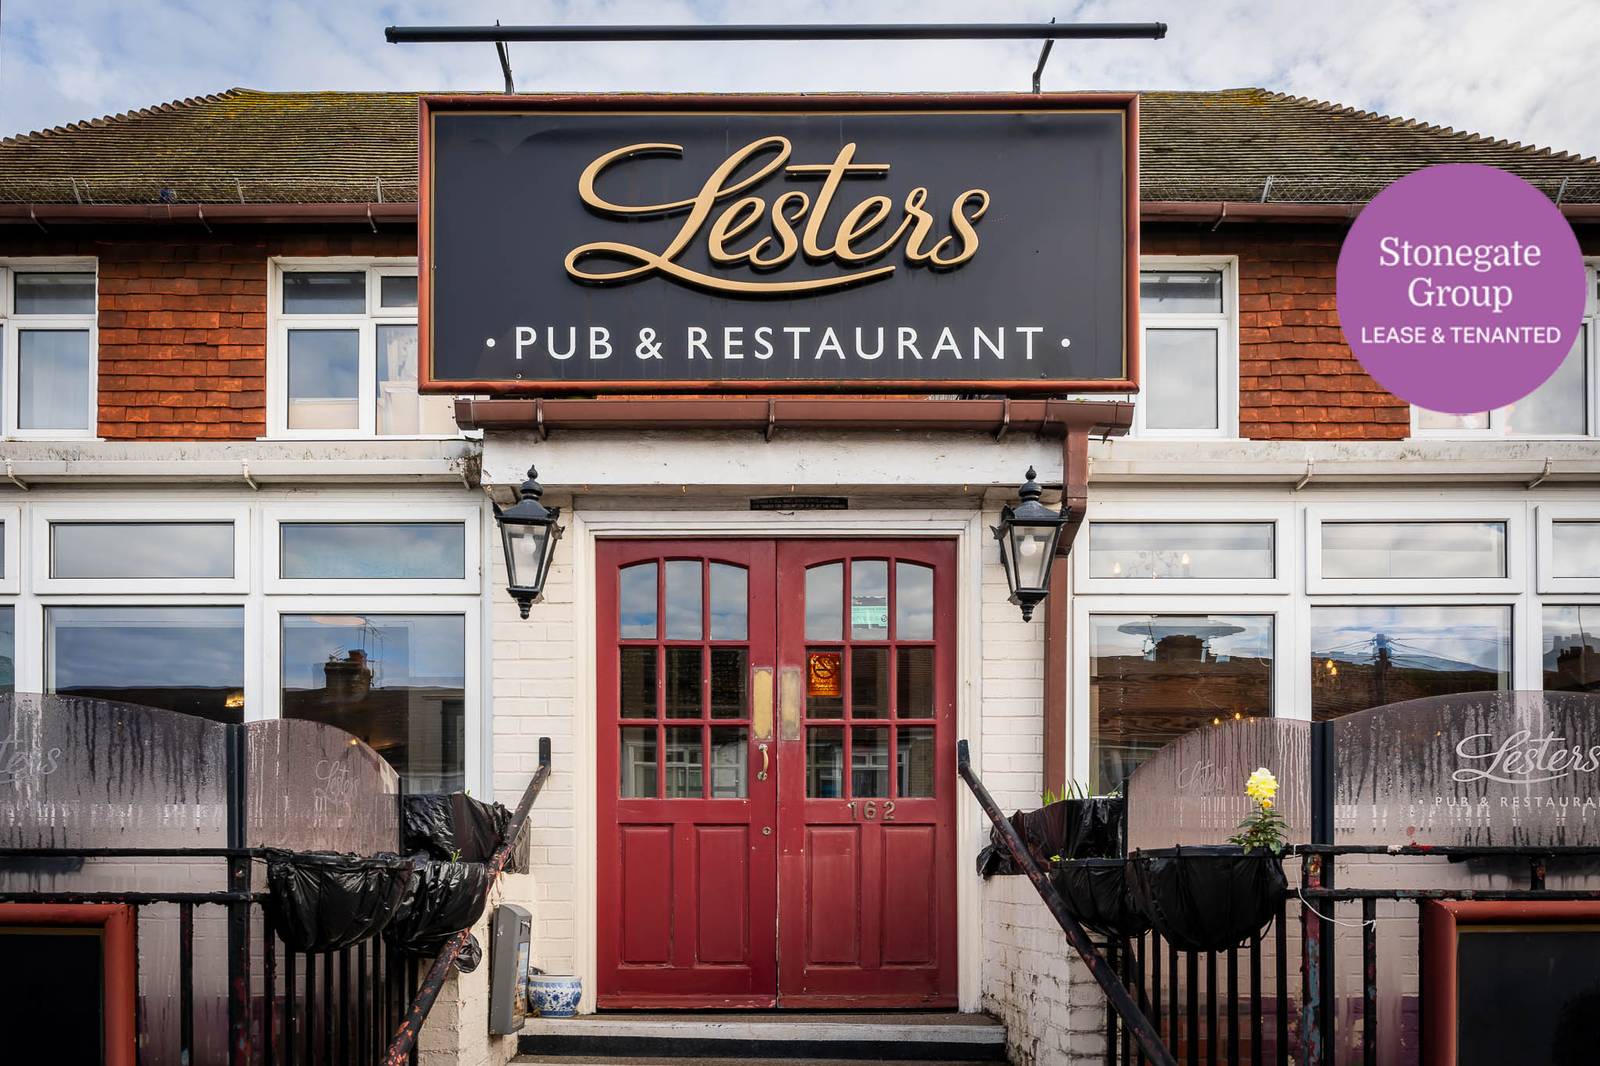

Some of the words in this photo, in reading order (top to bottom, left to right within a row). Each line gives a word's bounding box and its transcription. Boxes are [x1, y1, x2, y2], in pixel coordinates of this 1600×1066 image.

[565, 136, 990, 293] Lesters
[515, 327, 613, 360] PUB
[636, 327, 664, 360] &
[687, 327, 1044, 360] RESTAURANT
[1452, 730, 1600, 784] Lesters
[847, 801, 896, 821] 162
[1435, 797, 1468, 807] PUB
[1479, 797, 1488, 807] &
[1500, 797, 1600, 807] RESTAURA
